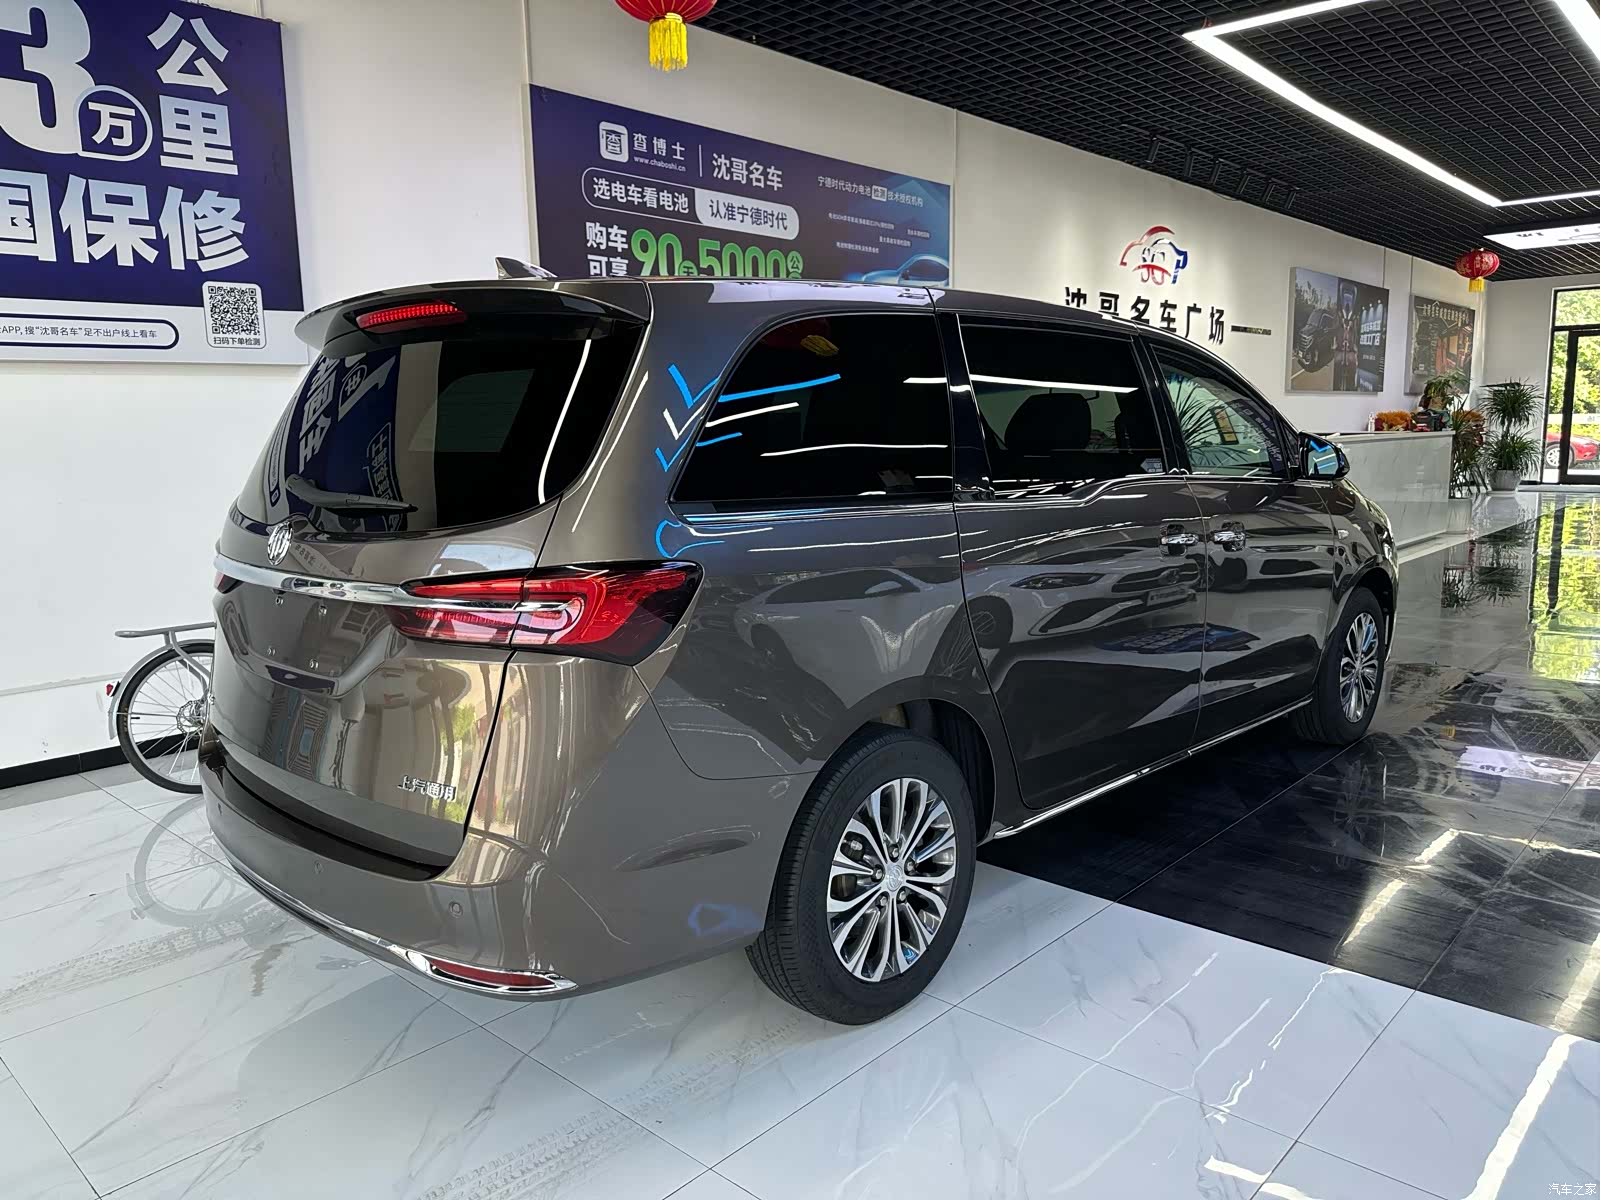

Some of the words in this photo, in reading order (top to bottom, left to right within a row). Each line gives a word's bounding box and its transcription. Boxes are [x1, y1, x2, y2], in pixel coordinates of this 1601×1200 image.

[87, 101, 136, 144] 万
[147, 12, 239, 175] 公里
[632, 132, 686, 161] 查博士
[633, 155, 686, 173] www.chaboshi.cn
[712, 152, 783, 191] 沈哥名车
[593, 176, 690, 214] 选电车看电池
[708, 199, 789, 231] 认准宁德时代
[584, 221, 628, 252] 购车
[397, 775, 457, 802] 上汽通用
